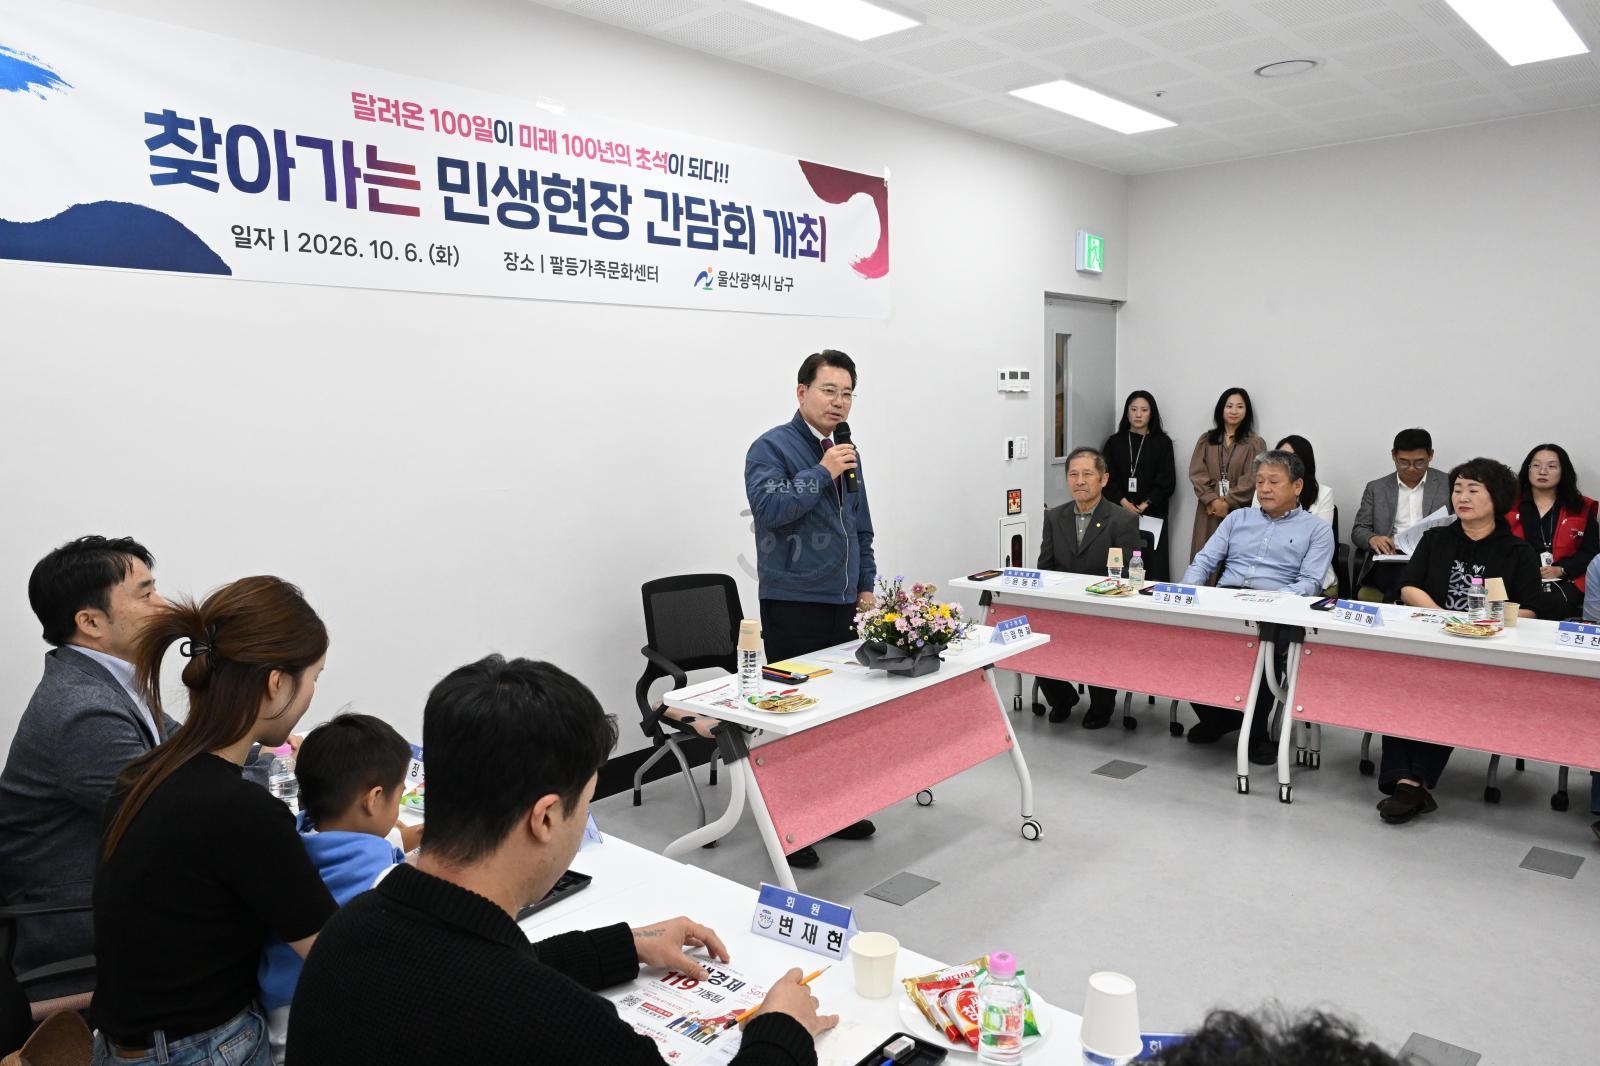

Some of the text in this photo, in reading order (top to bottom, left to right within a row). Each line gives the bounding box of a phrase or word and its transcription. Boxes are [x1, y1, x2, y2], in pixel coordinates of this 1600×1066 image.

[351, 91, 730, 184] 달려온 100일이 미래 100년의 초석이 되다!!
[144, 108, 827, 263] 찾아가는 민생현장 간담회 개최
[230, 224, 275, 251] 일자
[503, 251, 535, 272] 장소
[549, 255, 660, 284] 팔등가족문화센터
[717, 270, 795, 294] 울산광역시 남구
[660, 971, 700, 990] 119
